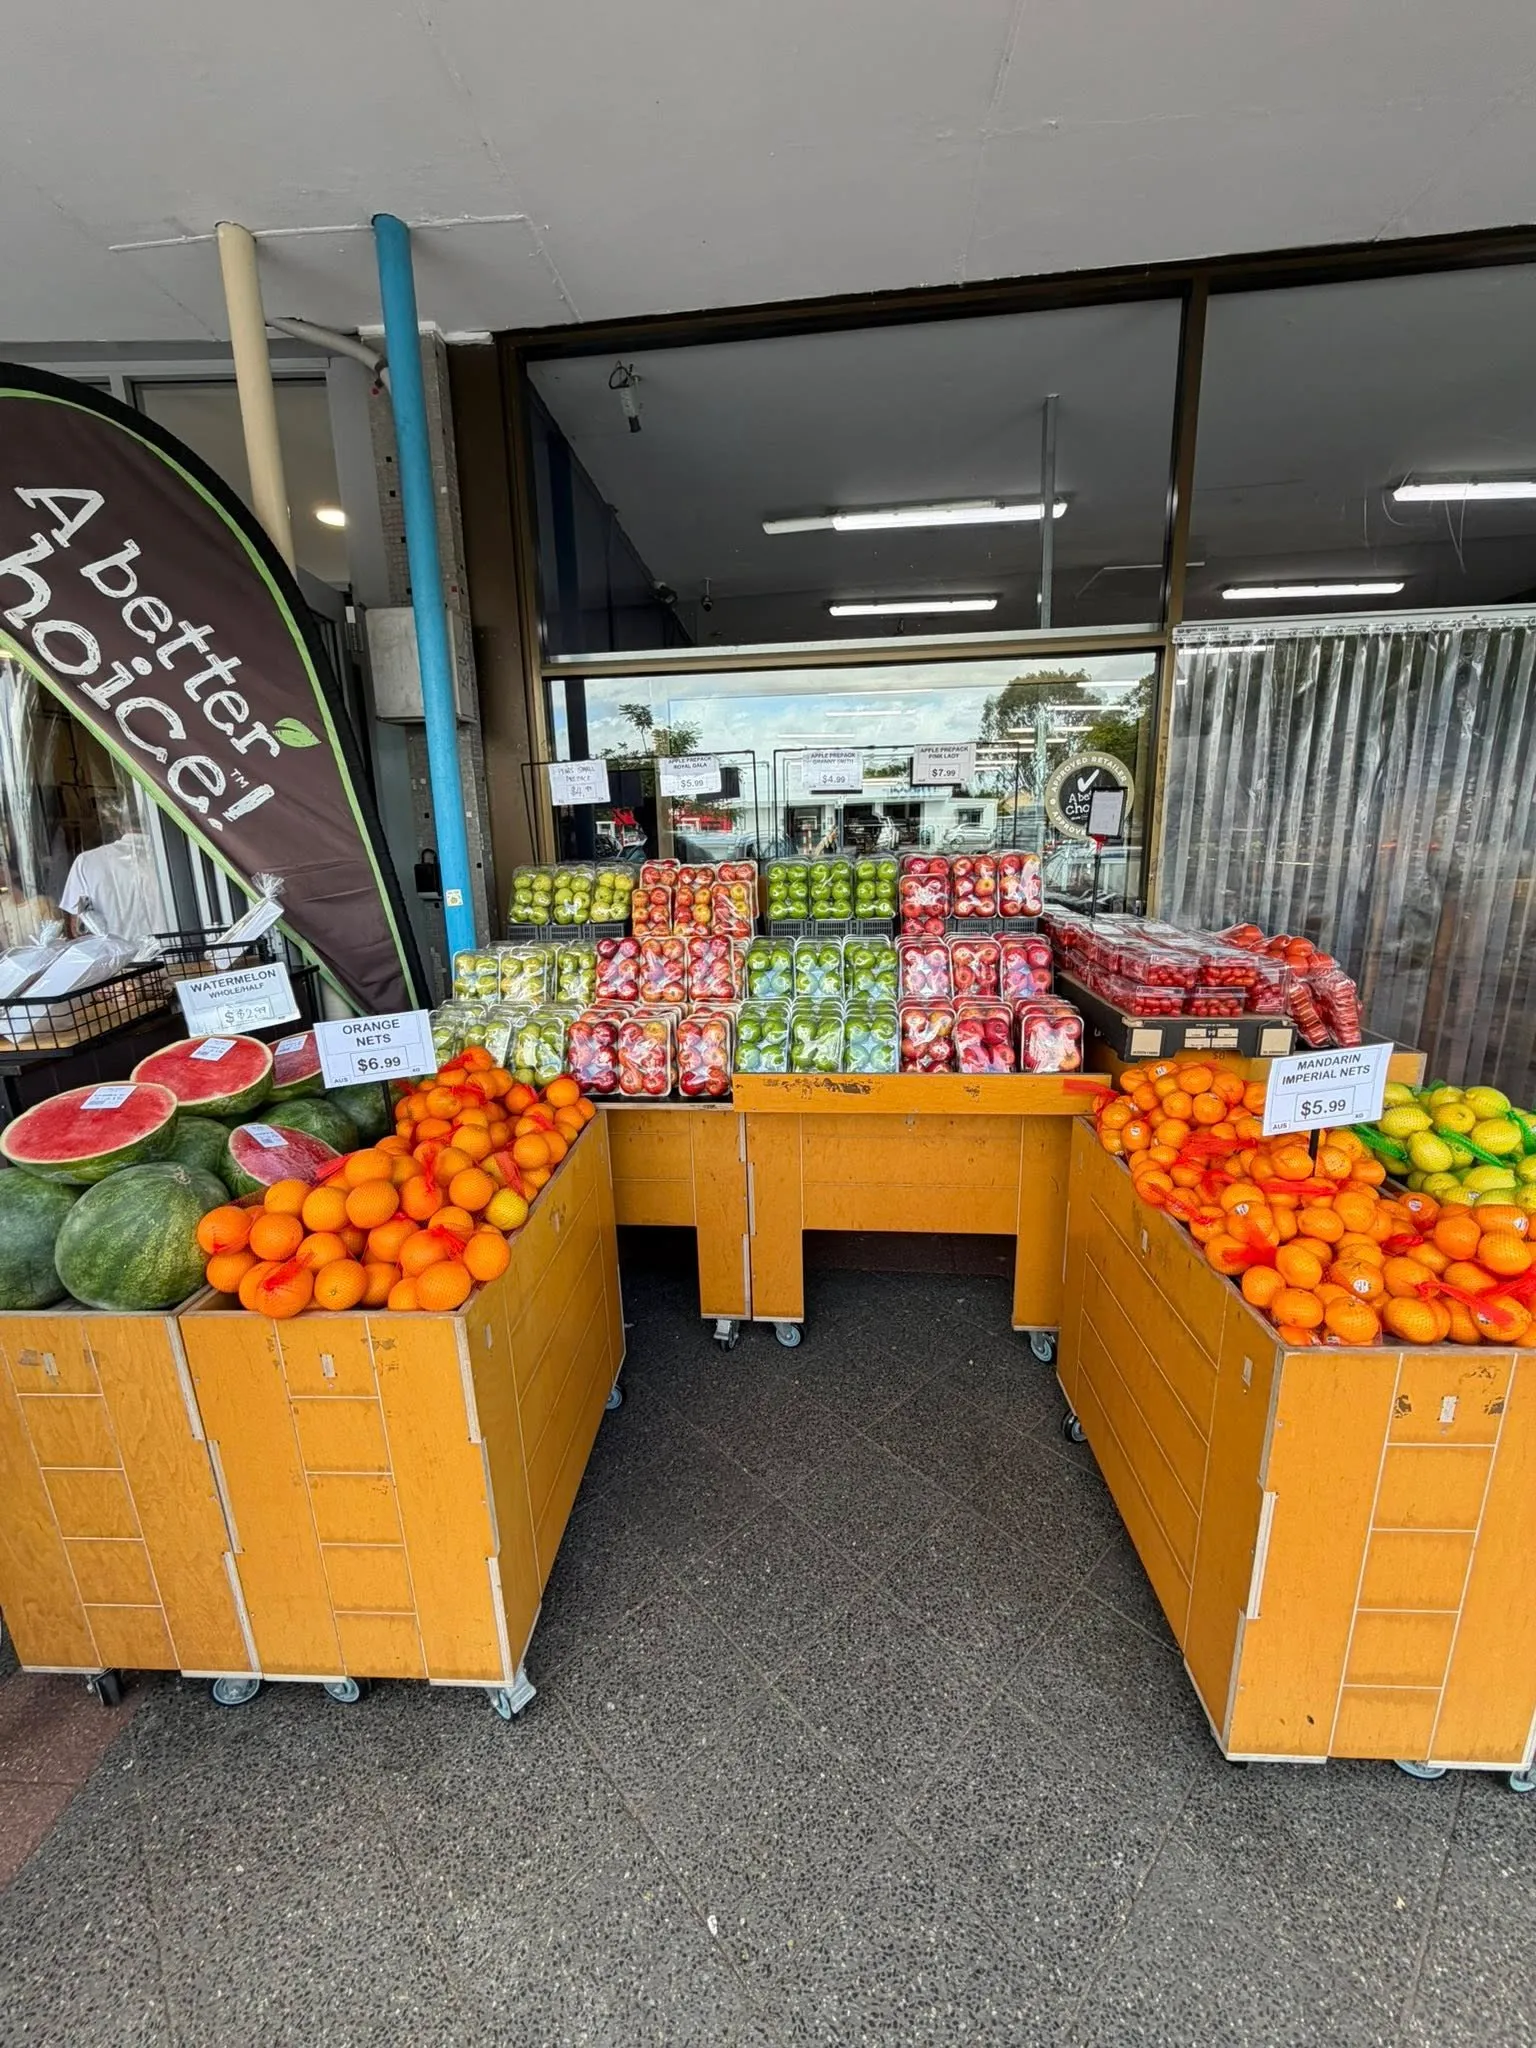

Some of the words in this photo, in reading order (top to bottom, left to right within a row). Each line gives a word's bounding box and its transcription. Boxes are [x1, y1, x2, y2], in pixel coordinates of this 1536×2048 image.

[14, 486, 106, 548] A
[80, 538, 281, 758] better
[0, 532, 275, 832] hoice!
[822, 774, 846, 784] $4.99
[931, 768, 956, 777] $7.99
[1051, 757, 1089, 793] APPROVED
[1091, 755, 1127, 782] RETAILER
[1068, 793, 1077, 803] A
[190, 969, 277, 993] WATERMELON
[208, 982, 265, 999] WHOLE/HALF
[342, 1019, 400, 1035] ORANGE
[356, 1034, 392, 1047] NETS
[357, 1056, 401, 1074] $6.99
[1297, 1053, 1361, 1070] MANDARIN
[1282, 1070, 1337, 1085] IMPERIAL
[1339, 1064, 1371, 1077] NETS
[1300, 1099, 1346, 1119] $5.99
